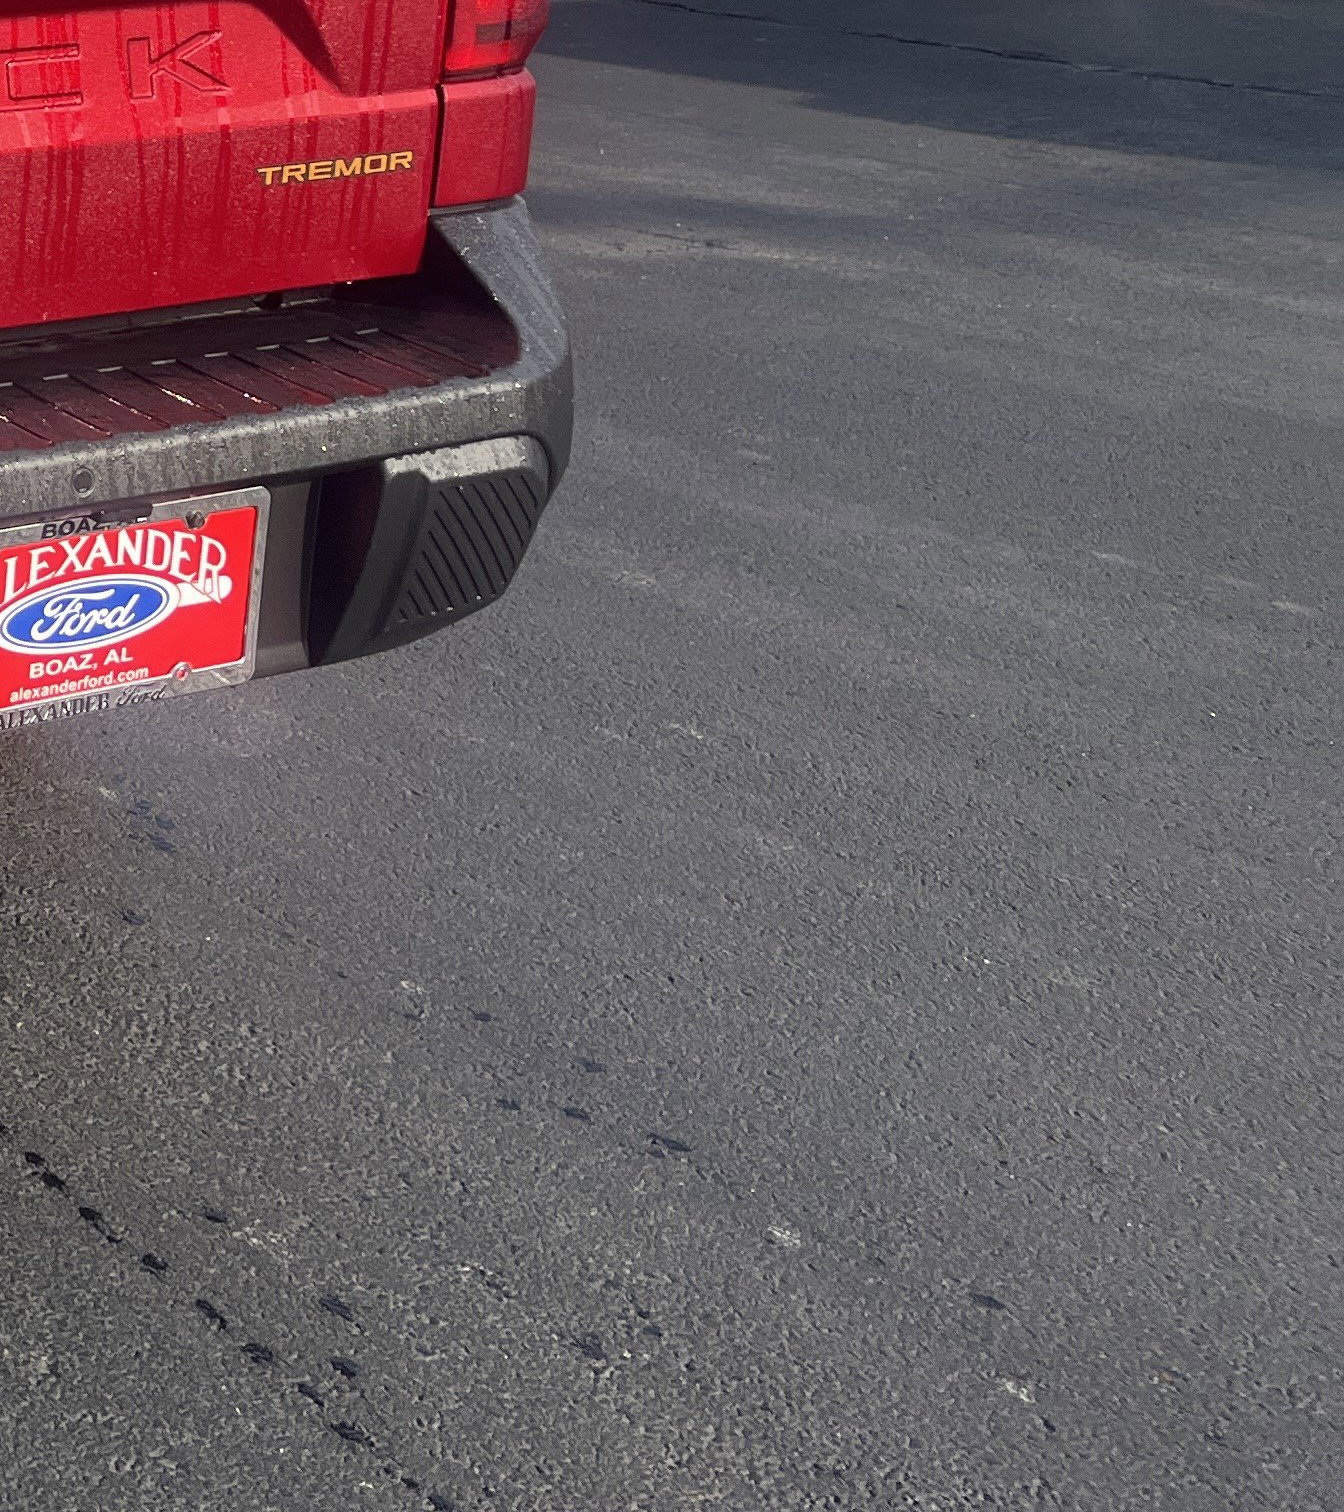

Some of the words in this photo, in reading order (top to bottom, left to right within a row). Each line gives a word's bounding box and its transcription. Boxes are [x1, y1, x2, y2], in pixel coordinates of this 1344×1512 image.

[257, 150, 414, 186] TREMOR
[30, 588, 137, 642] Ford
[29, 654, 98, 680] BOAZ,
[100, 648, 134, 665] AL
[9, 665, 150, 704] alexanderford.com
